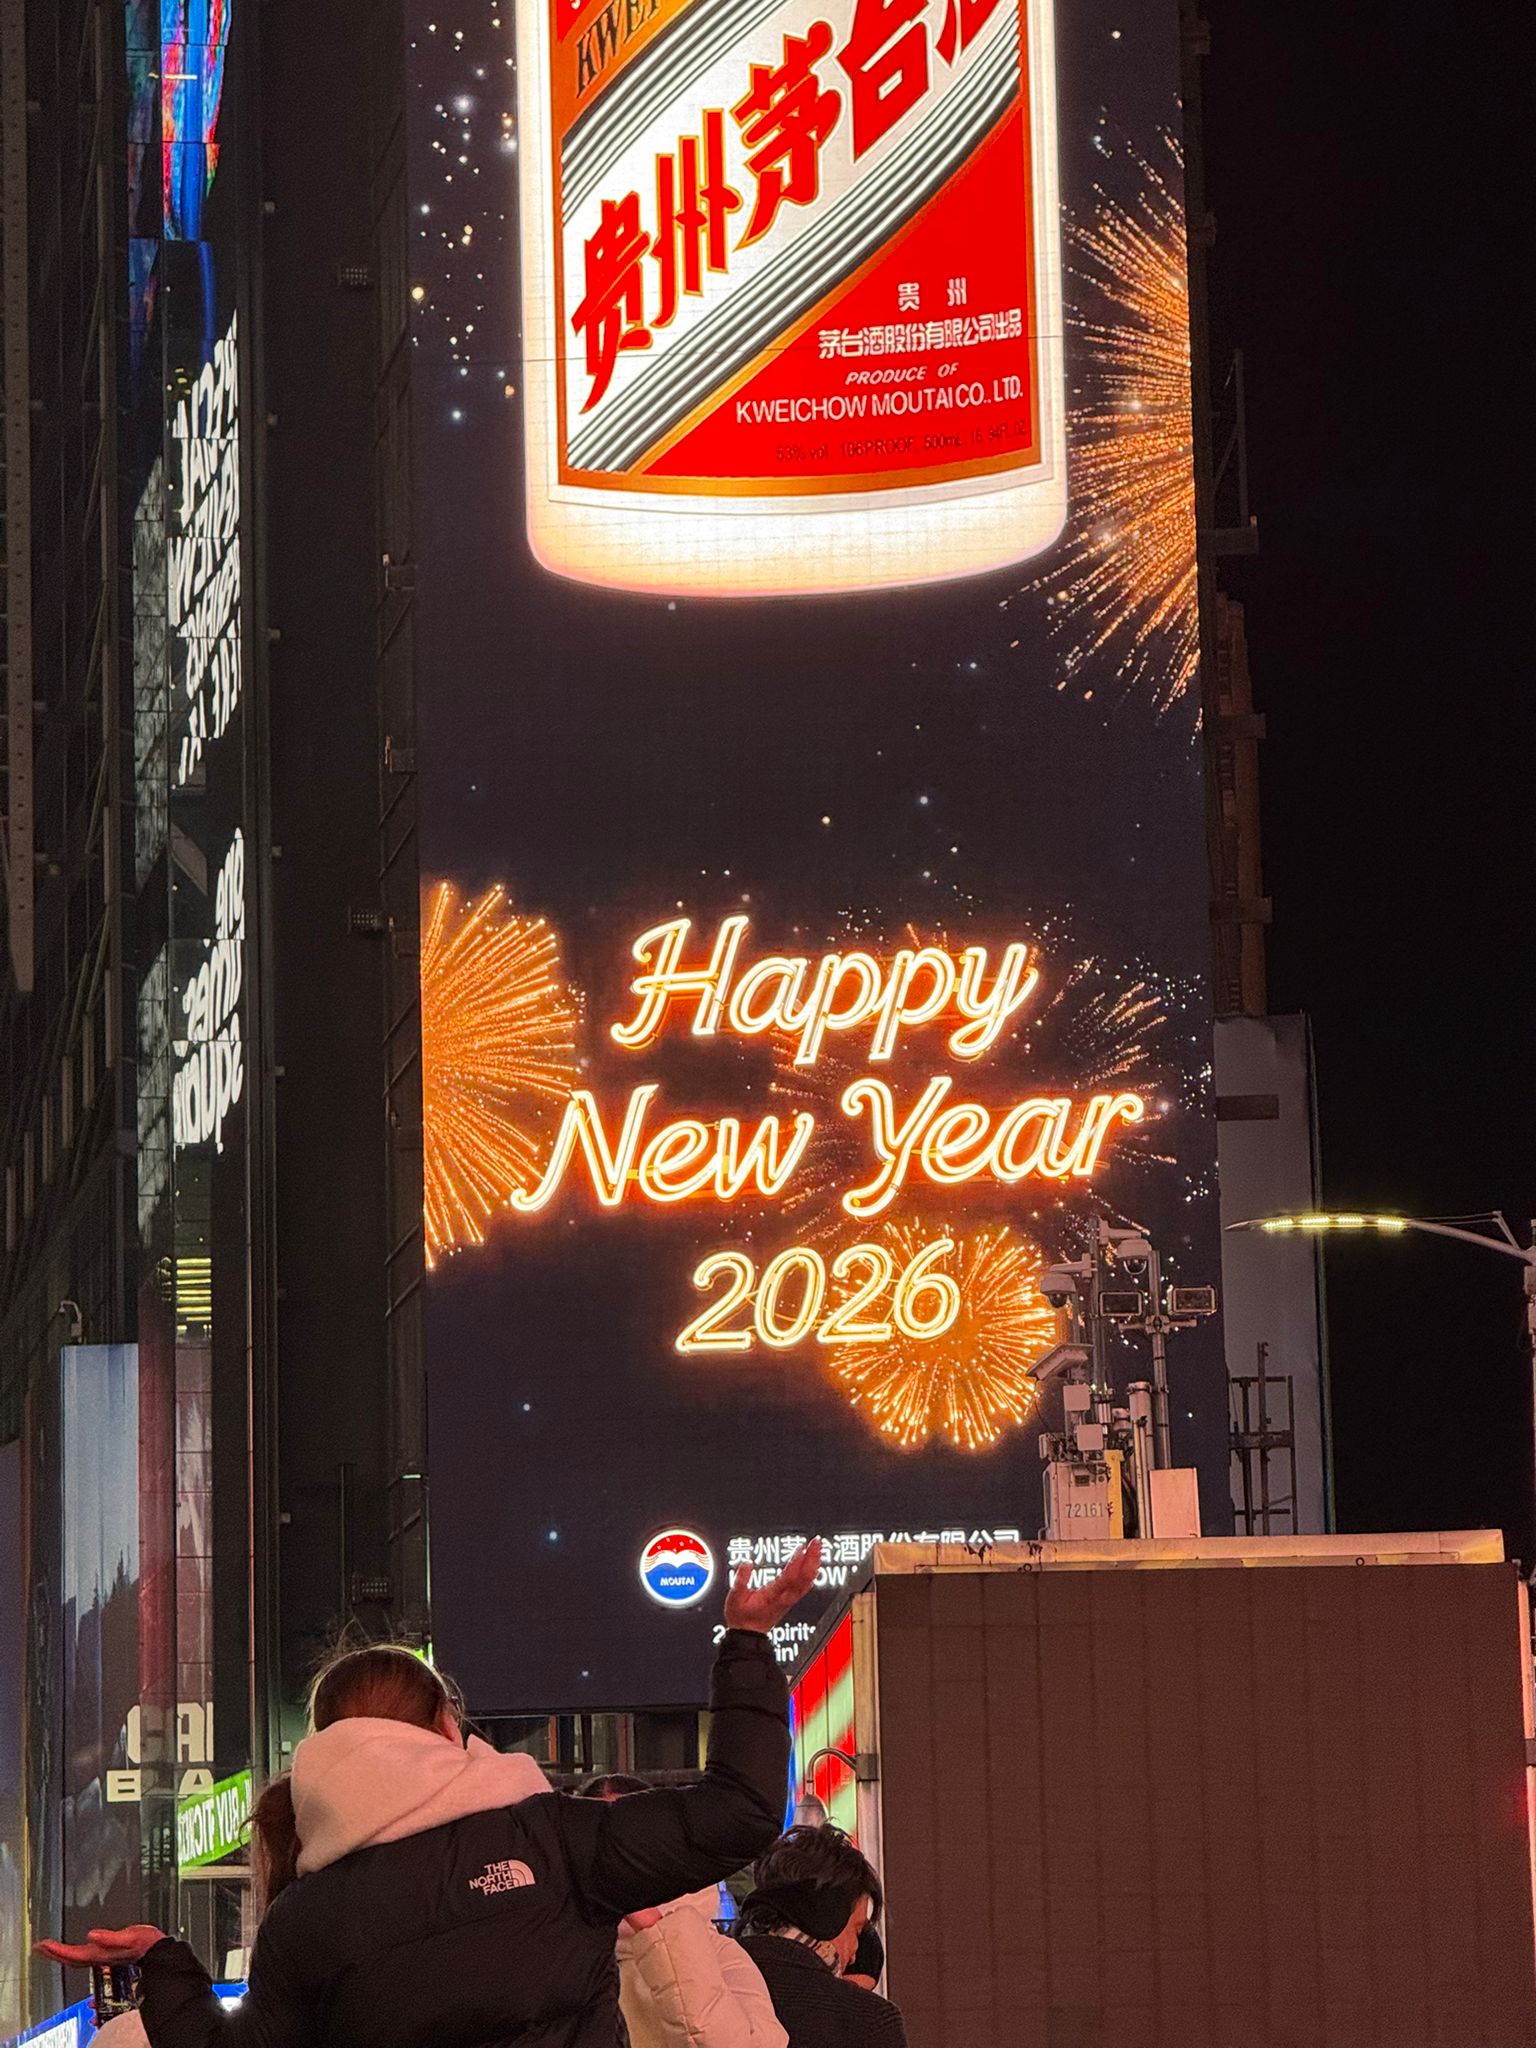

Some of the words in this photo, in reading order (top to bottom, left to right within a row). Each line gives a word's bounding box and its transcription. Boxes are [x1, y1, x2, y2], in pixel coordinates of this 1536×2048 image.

[818, 308, 1022, 360] 茅台酒股份有限公司出品
[845, 366, 927, 385] PRODUCE
[938, 361, 959, 378] OF
[735, 395, 868, 424] KWEICHOW
[871, 386, 953, 416] MOUTAI
[611, 914, 1038, 1065] Happy
[510, 1083, 814, 1212] New
[841, 1076, 1144, 1218] Year
[675, 1239, 962, 1355] 2026
[660, 1576, 695, 1587] MOUTAI
[468, 1871, 512, 1890] NORTH
[484, 1861, 509, 1875] THE
[483, 1880, 515, 1896] FACE
